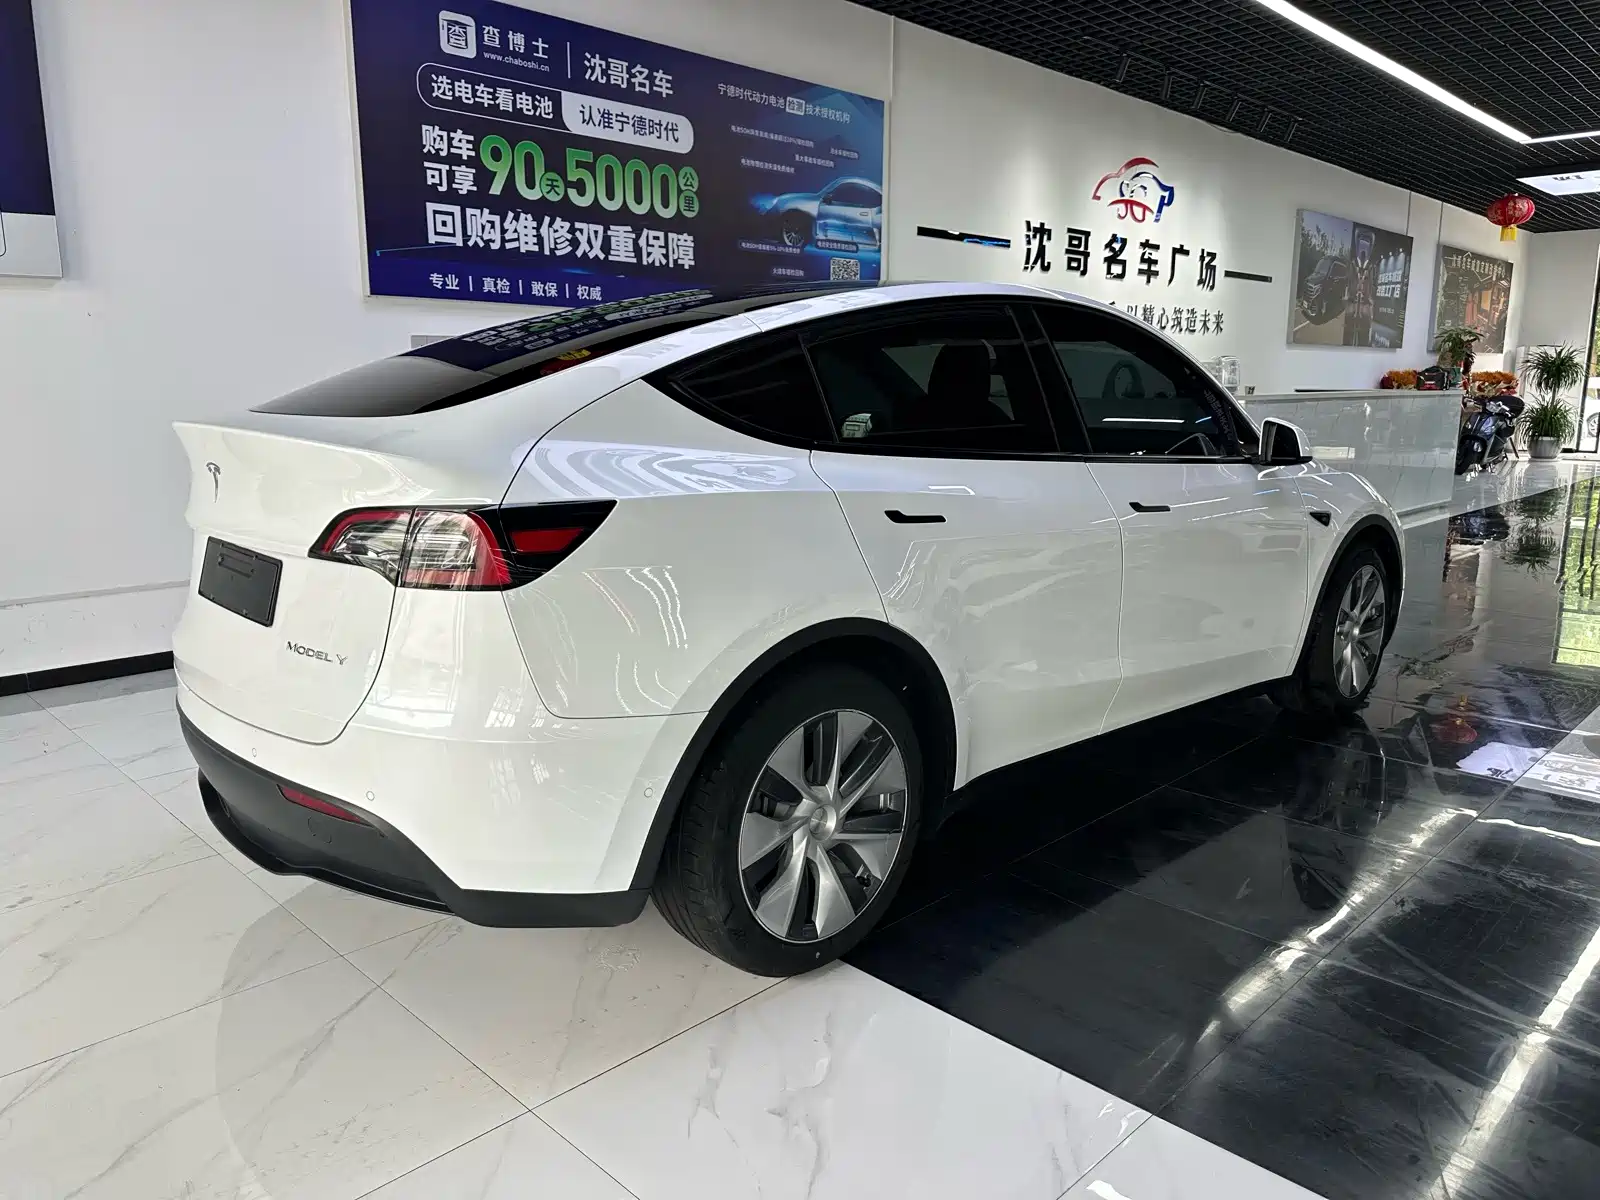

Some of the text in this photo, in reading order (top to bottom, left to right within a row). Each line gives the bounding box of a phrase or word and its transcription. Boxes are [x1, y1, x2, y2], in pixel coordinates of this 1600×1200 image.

[482, 25, 549, 59] 查博士
[483, 51, 550, 72] www.chaboshi.cn
[584, 52, 674, 97] 沈哥名车
[431, 74, 553, 119] 选电车看电池
[579, 104, 680, 143] 认准宁德时代
[421, 124, 476, 160] 购车
[423, 161, 478, 195] 可享
[425, 202, 696, 270] 回购维修双重保障
[1023, 220, 1218, 292] 沈哥名车广场
[429, 273, 602, 300] 专业 真检 敢保 权威
[286, 641, 348, 667] MODEL Y
